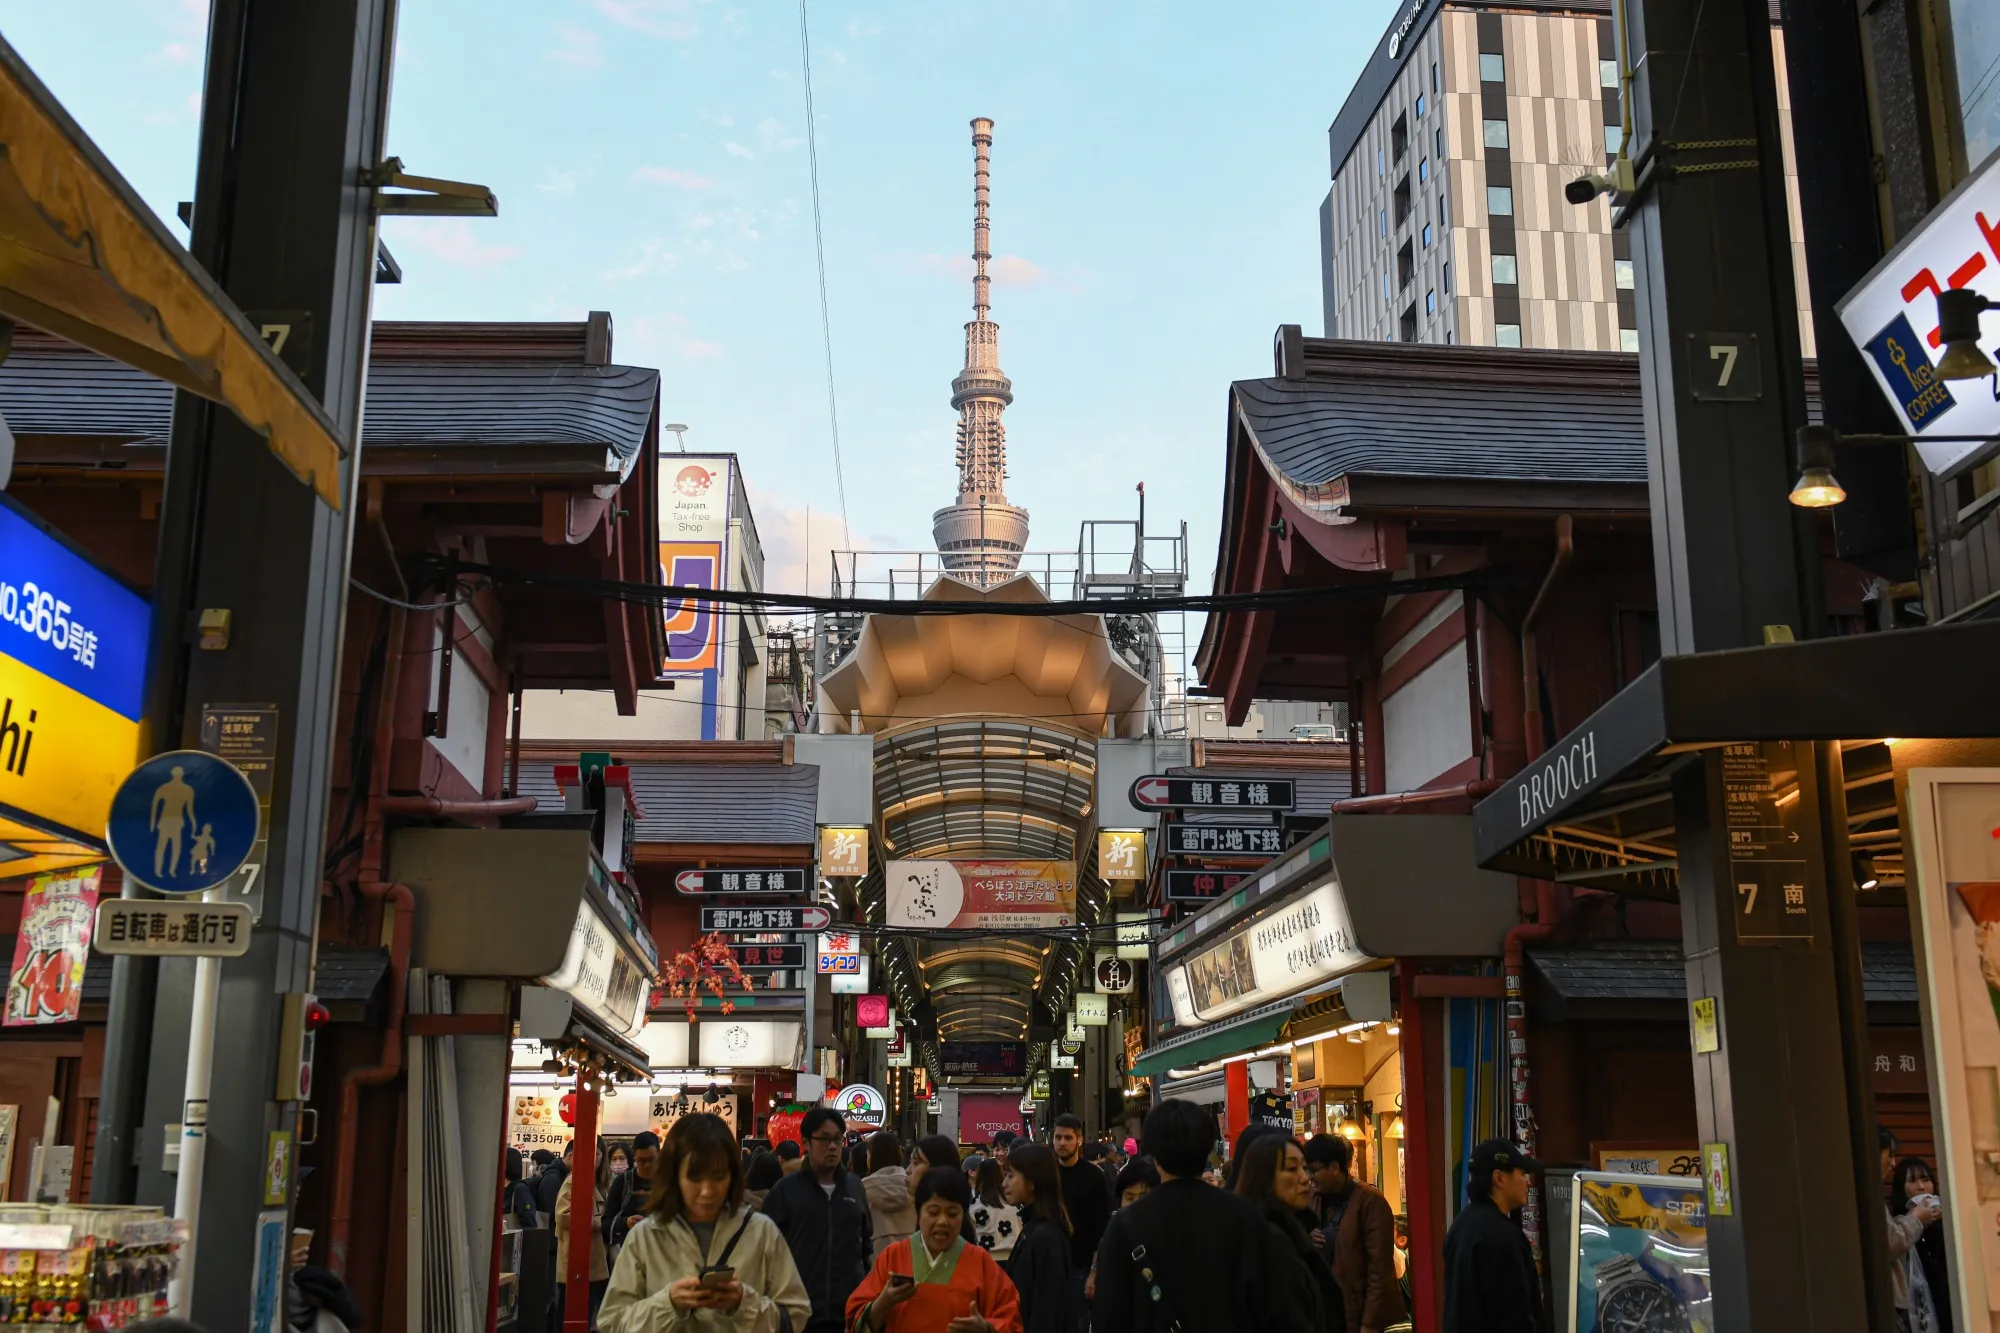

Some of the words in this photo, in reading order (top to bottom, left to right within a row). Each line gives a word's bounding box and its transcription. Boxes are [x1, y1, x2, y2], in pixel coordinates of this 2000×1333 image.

[1398, 8, 1413, 41] TOBU
[261, 324, 291, 355] 7
[1709, 345, 1738, 386] 7
[1912, 361, 1936, 392] KEY
[1906, 383, 1948, 421] COFFEE
[672, 512, 710, 521] Tax-free
[678, 522, 703, 533] Shop
[1518, 731, 1598, 828] BROOCH
[1191, 782, 1269, 805] 観音様
[828, 832, 862, 864] 新
[1181, 828, 1281, 851] 雷門:地下鉄
[1730, 832, 1752, 842] 雷門
[1105, 836, 1138, 868] 新
[239, 863, 261, 895] 7
[721, 873, 785, 891] 観音様
[995, 891, 1056, 902] 大河ドラマ館
[1738, 884, 1758, 914] 7
[1783, 883, 1804, 905] 南
[713, 909, 793, 929] 雷門:地下鉄
[1785, 906, 1807, 914] South
[110, 911, 239, 944] 自転車は通行可
[729, 946, 785, 965] 見世
[821, 955, 858, 970] ダイコク
[1874, 1055, 1916, 1073] 舟和
[1262, 1114, 1293, 1130] TOKYO
[516, 1133, 563, 1145] 1袋350円
[1666, 1200, 1706, 1218] SEI
